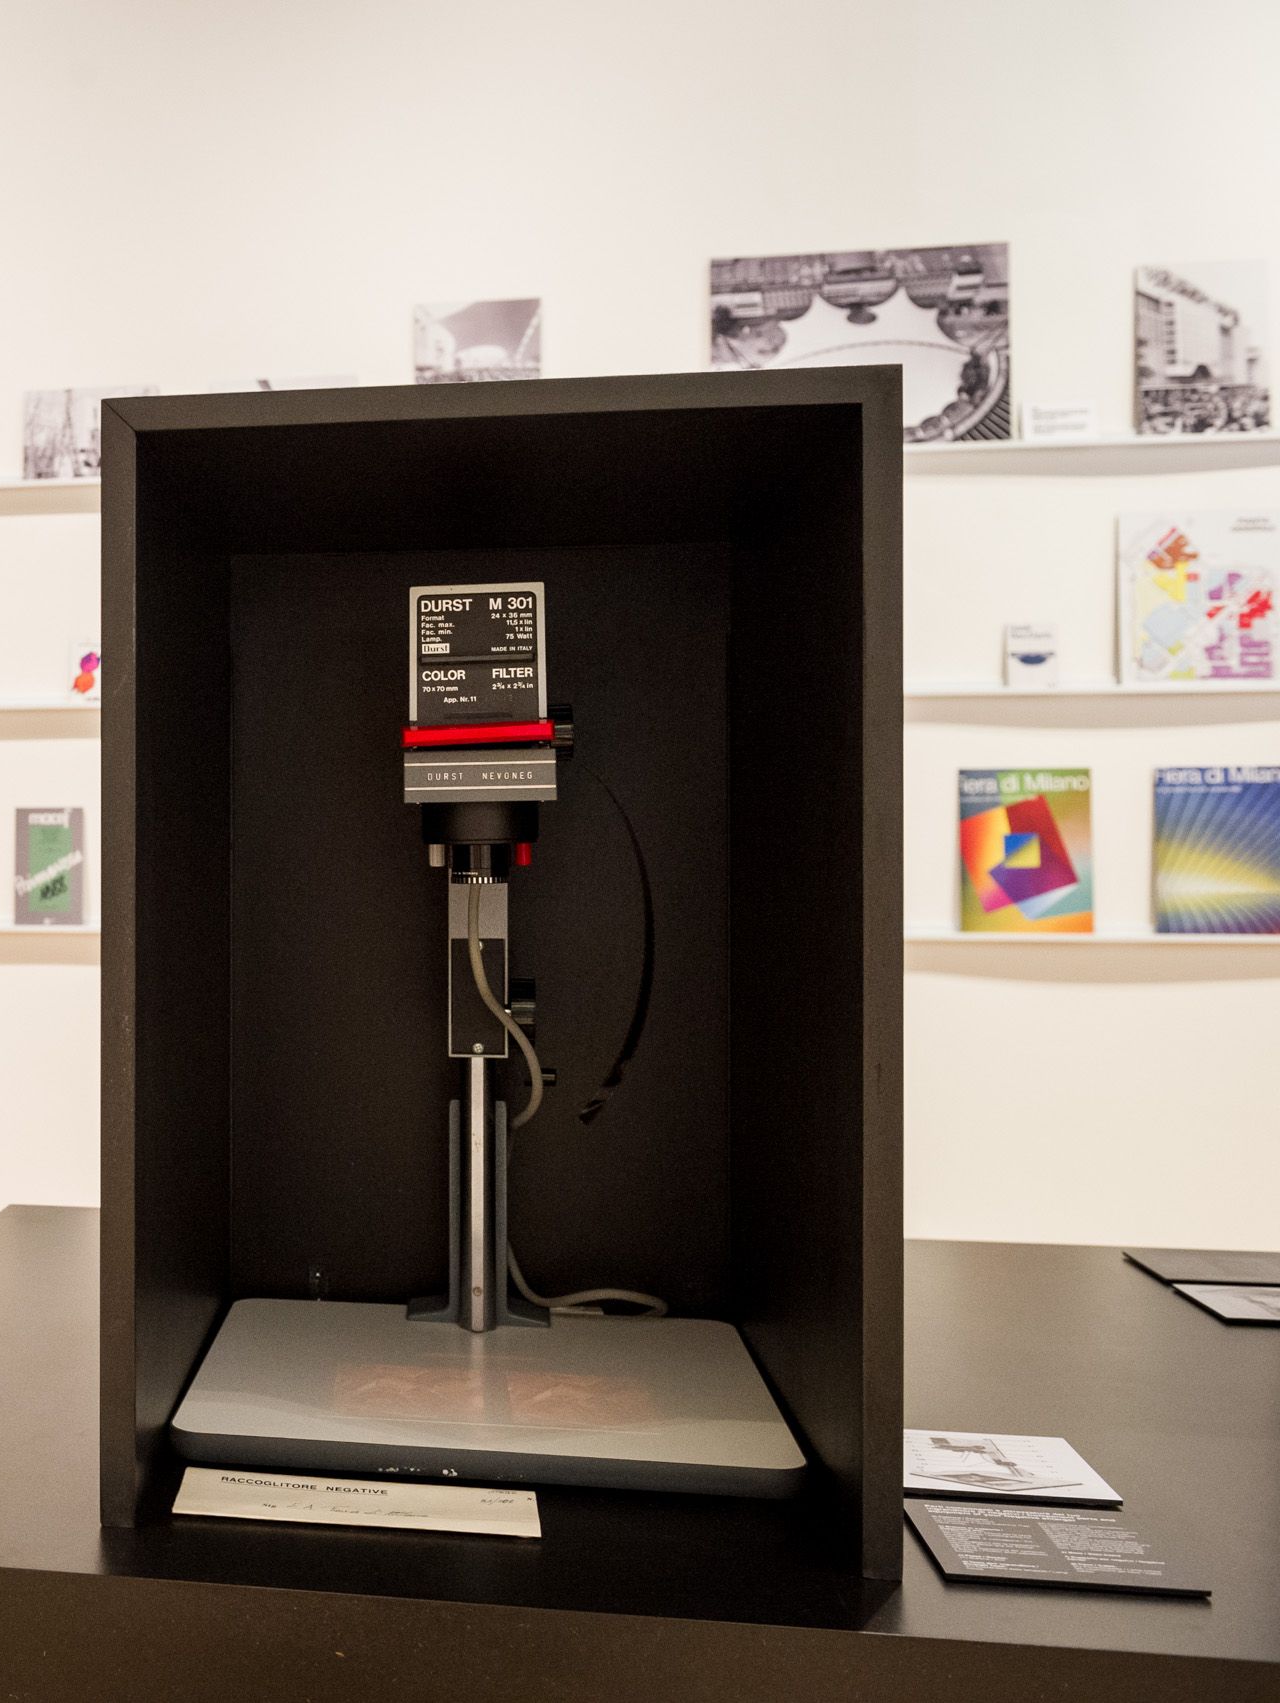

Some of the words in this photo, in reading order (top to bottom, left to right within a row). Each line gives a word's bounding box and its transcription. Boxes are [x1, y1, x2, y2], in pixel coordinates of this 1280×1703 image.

[421, 599, 472, 613] DURST
[489, 598, 502, 611] M
[507, 597, 533, 610] 301
[423, 644, 448, 653] Durst
[422, 670, 466, 681] COLOR
[492, 667, 533, 679] FILTER
[443, 696, 458, 704] App.
[427, 772, 463, 781] DURST
[482, 771, 533, 780] NEVONEG
[221, 1475, 318, 1491] RACCOGLITORE
[325, 1486, 389, 1496] NEGATIVE
